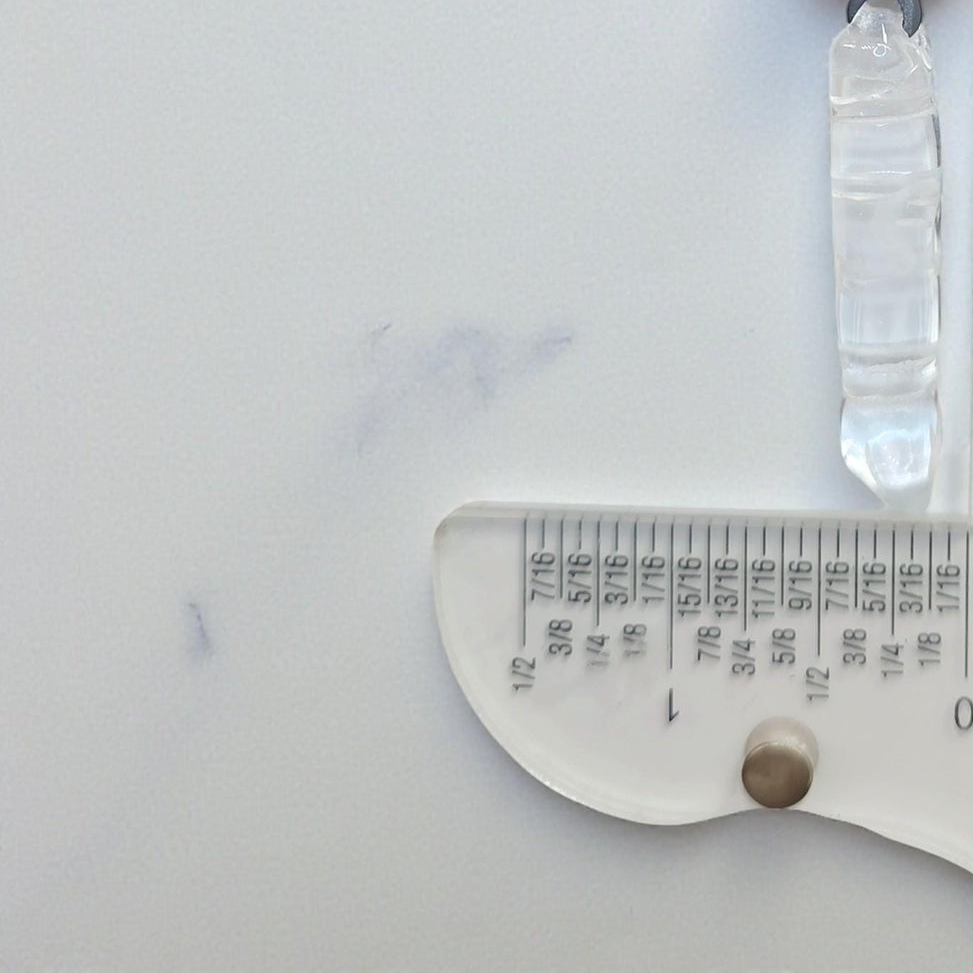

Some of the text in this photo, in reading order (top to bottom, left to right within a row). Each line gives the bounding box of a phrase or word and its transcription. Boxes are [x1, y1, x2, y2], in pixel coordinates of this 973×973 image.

[531, 551, 555, 602] 7/16
[568, 553, 592, 604] 5/16
[604, 554, 629, 605] 3/16
[642, 555, 666, 603] 1/16
[678, 557, 702, 618] 15/16
[715, 558, 739, 618] 13/16
[752, 559, 776, 619] 11/16
[788, 560, 812, 611] 9/16
[826, 562, 849, 611] 7/16
[862, 562, 886, 613] 5/16
[900, 563, 924, 614] 3/16
[937, 564, 960, 613] 1/16
[549, 619, 573, 657] 3/8
[697, 626, 722, 662] 7/8
[732, 638, 756, 676] 3/4
[772, 628, 796, 665] 5/8
[843, 628, 867, 665] 3/8
[882, 643, 904, 678] 1/4
[918, 632, 942, 668] 1/8
[512, 656, 536, 691] 1/2
[806, 666, 830, 702] 1/2
[669, 688, 679, 723] 1
